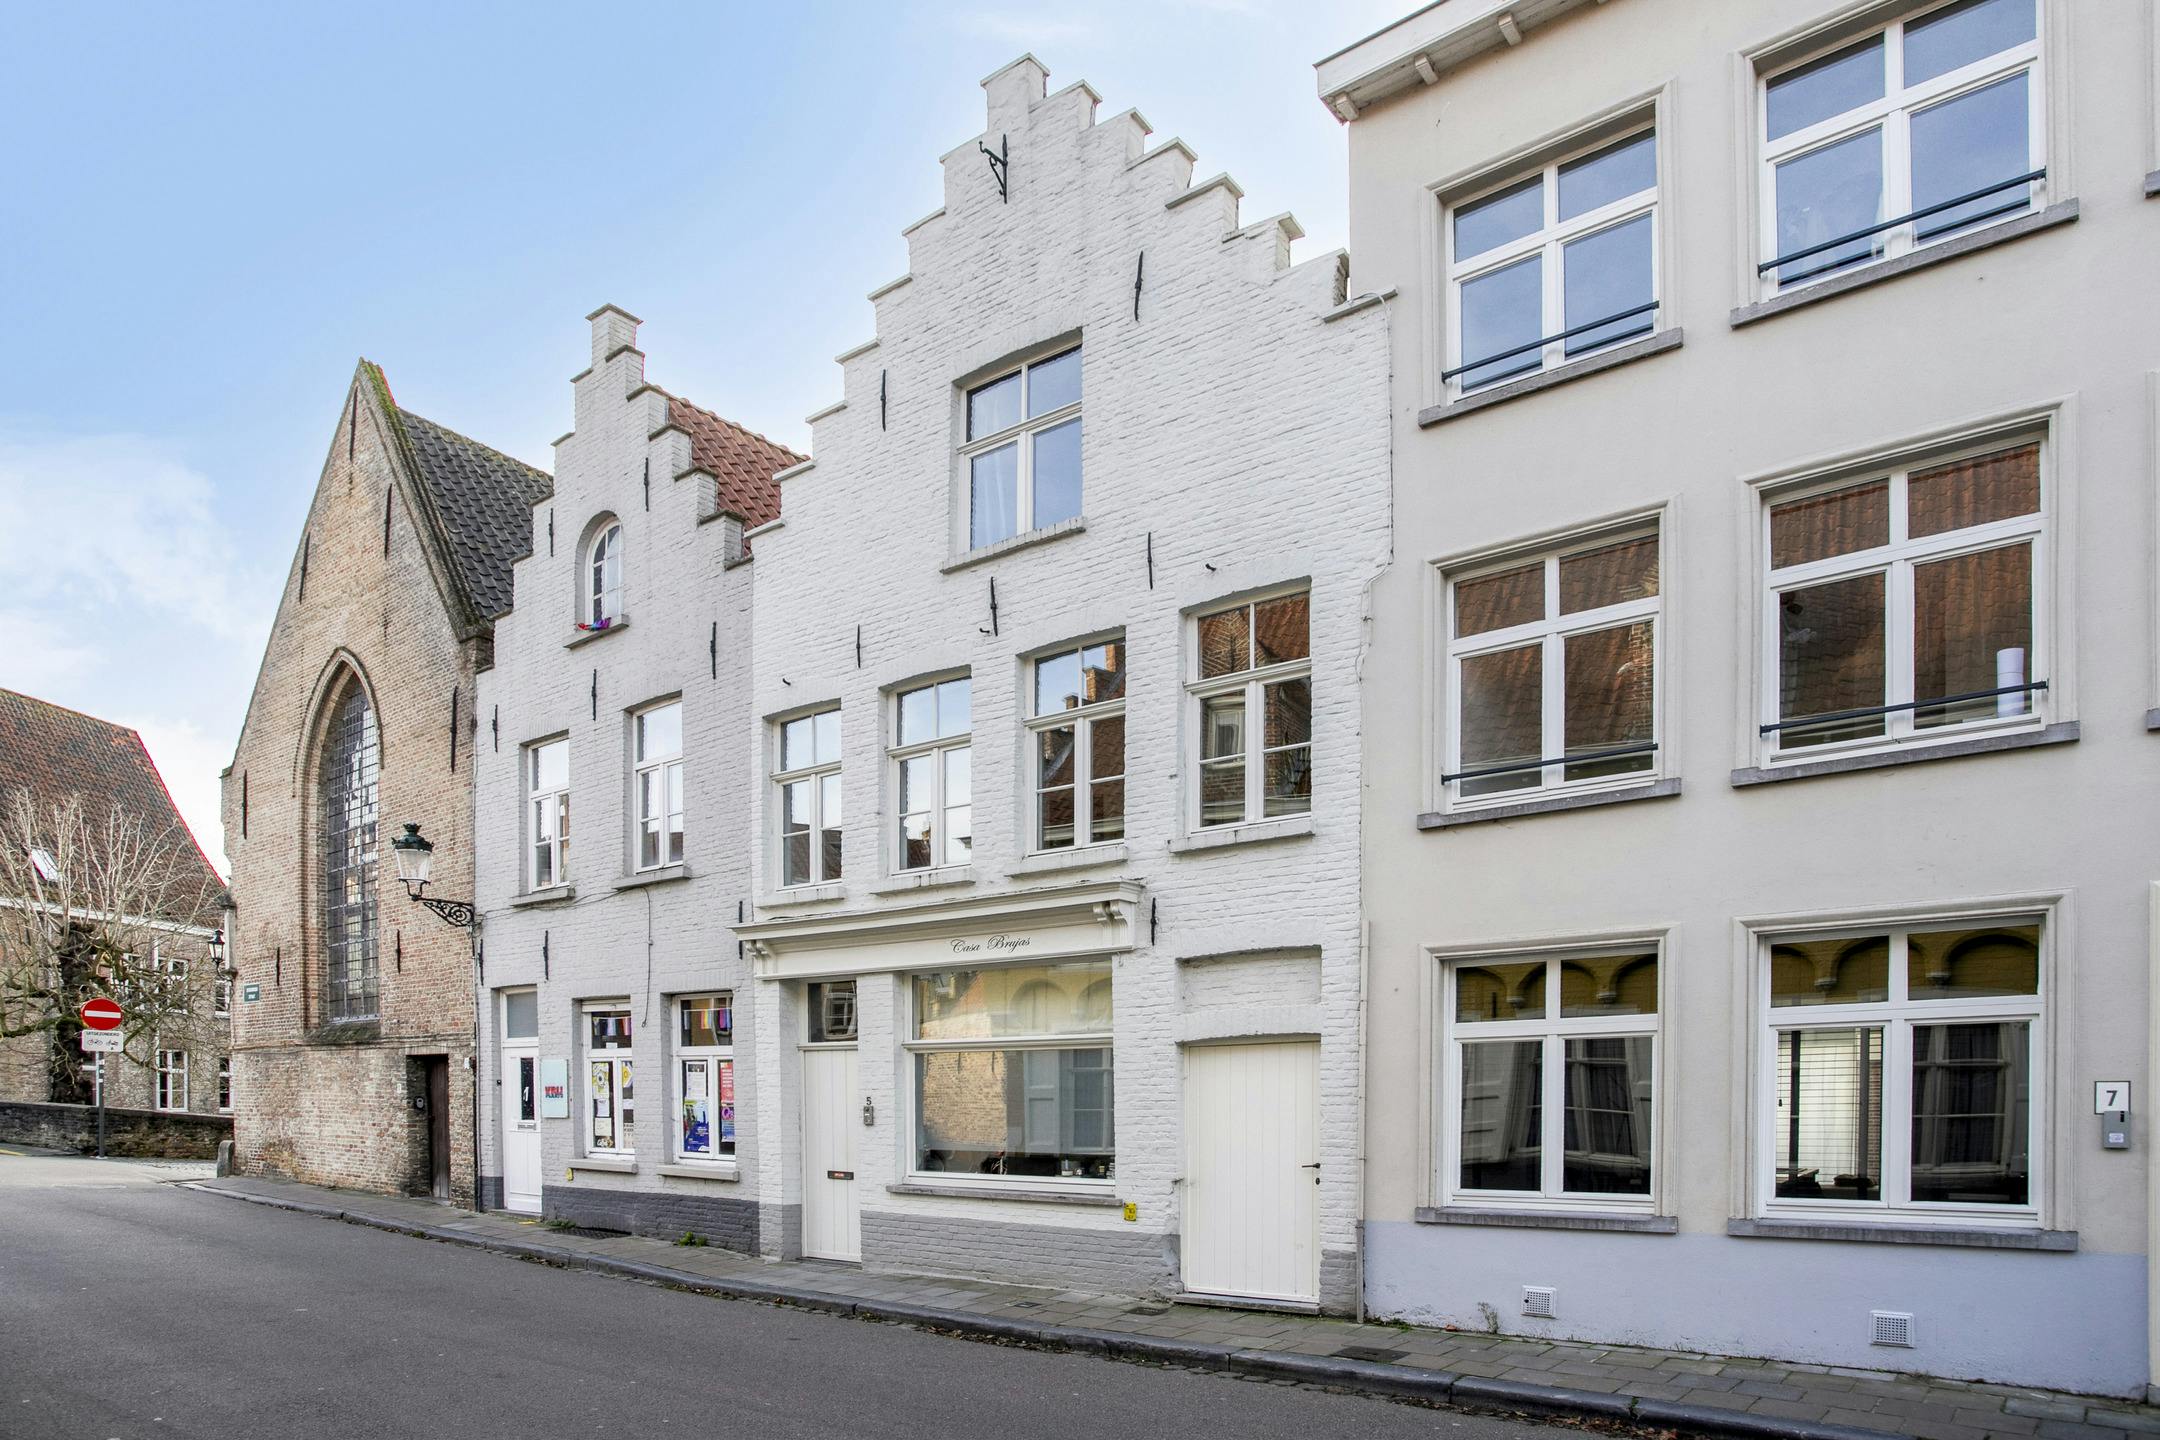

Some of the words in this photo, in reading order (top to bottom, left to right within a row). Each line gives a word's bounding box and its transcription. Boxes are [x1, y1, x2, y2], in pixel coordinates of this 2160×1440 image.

[950, 939, 980, 953] Casa
[987, 934, 1031, 953] Brujas
[866, 1096, 872, 1106] 5
[2106, 1090, 2118, 1107] 7
